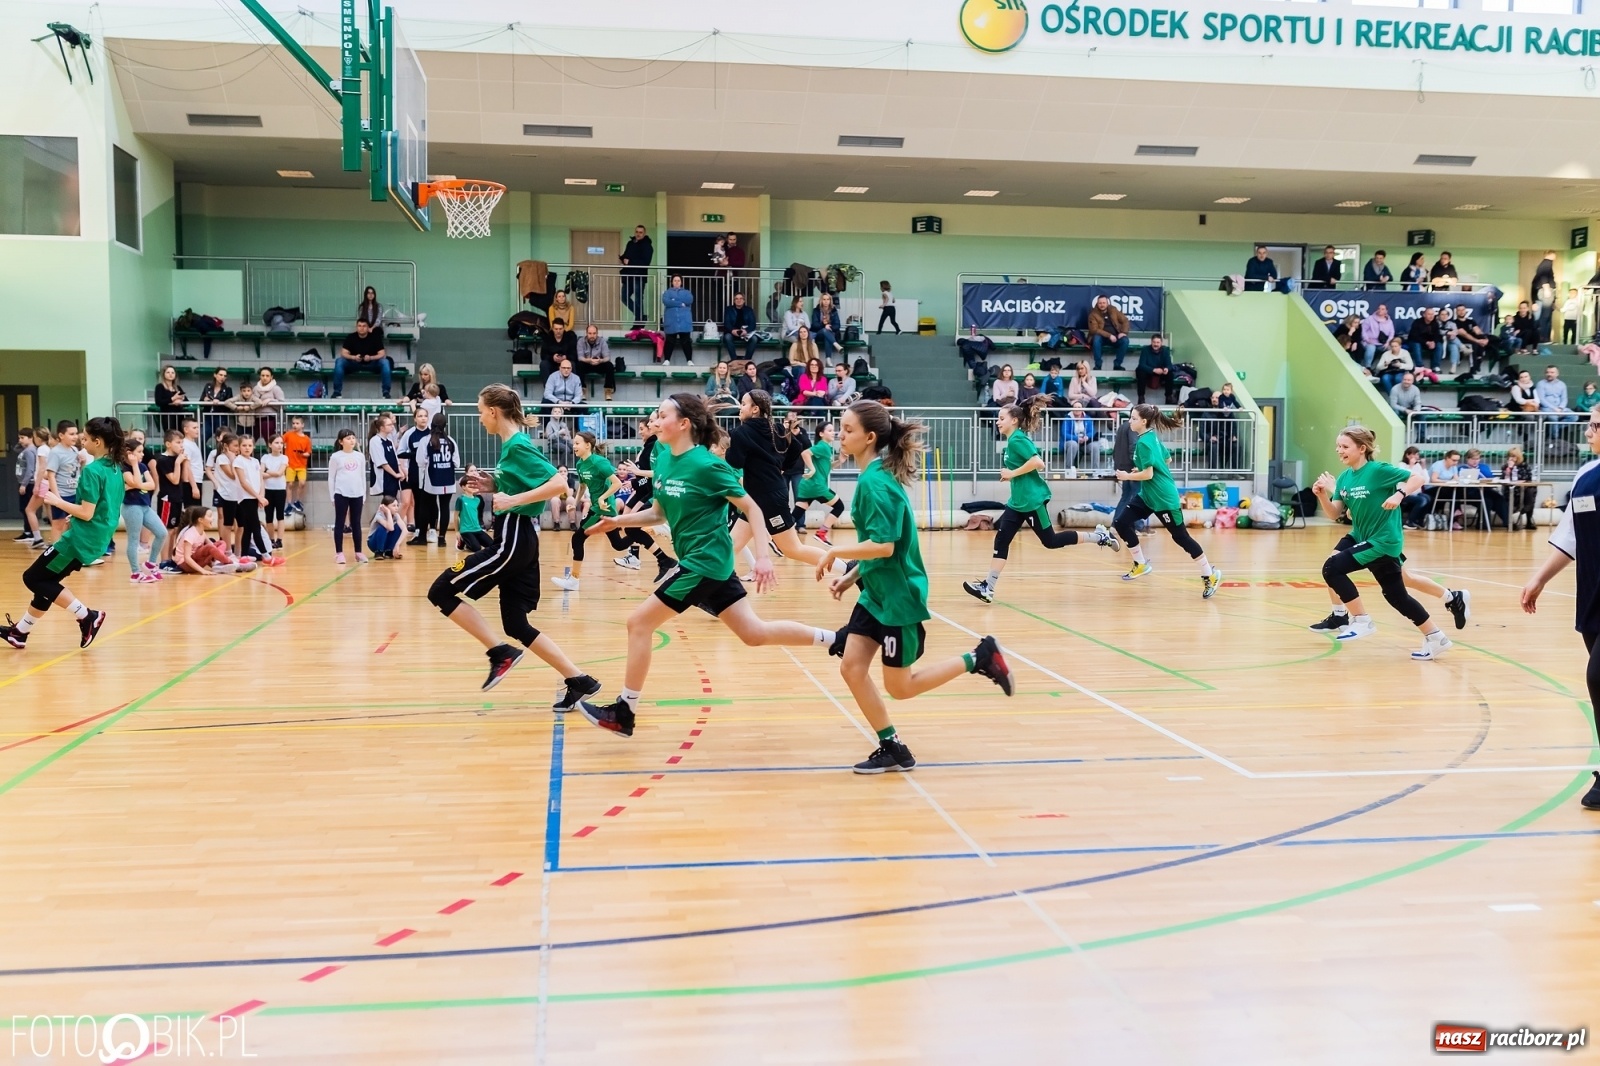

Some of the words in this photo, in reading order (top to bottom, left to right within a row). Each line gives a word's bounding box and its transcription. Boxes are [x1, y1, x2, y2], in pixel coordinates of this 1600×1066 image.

[343, 0, 353, 57] SMENPOL
[1041, 0, 1189, 39] OŚRODEK
[1202, 12, 1325, 45] SPORTU
[1336, 18, 1342, 46] I
[1355, 19, 1513, 53] REKREACJI
[916, 221, 926, 232] E
[933, 222, 940, 232] E
[1413, 234, 1425, 245] F
[1575, 234, 1585, 246] F
[981, 296, 1066, 314] RACIBÓRZ
[883, 635, 897, 658] 10
